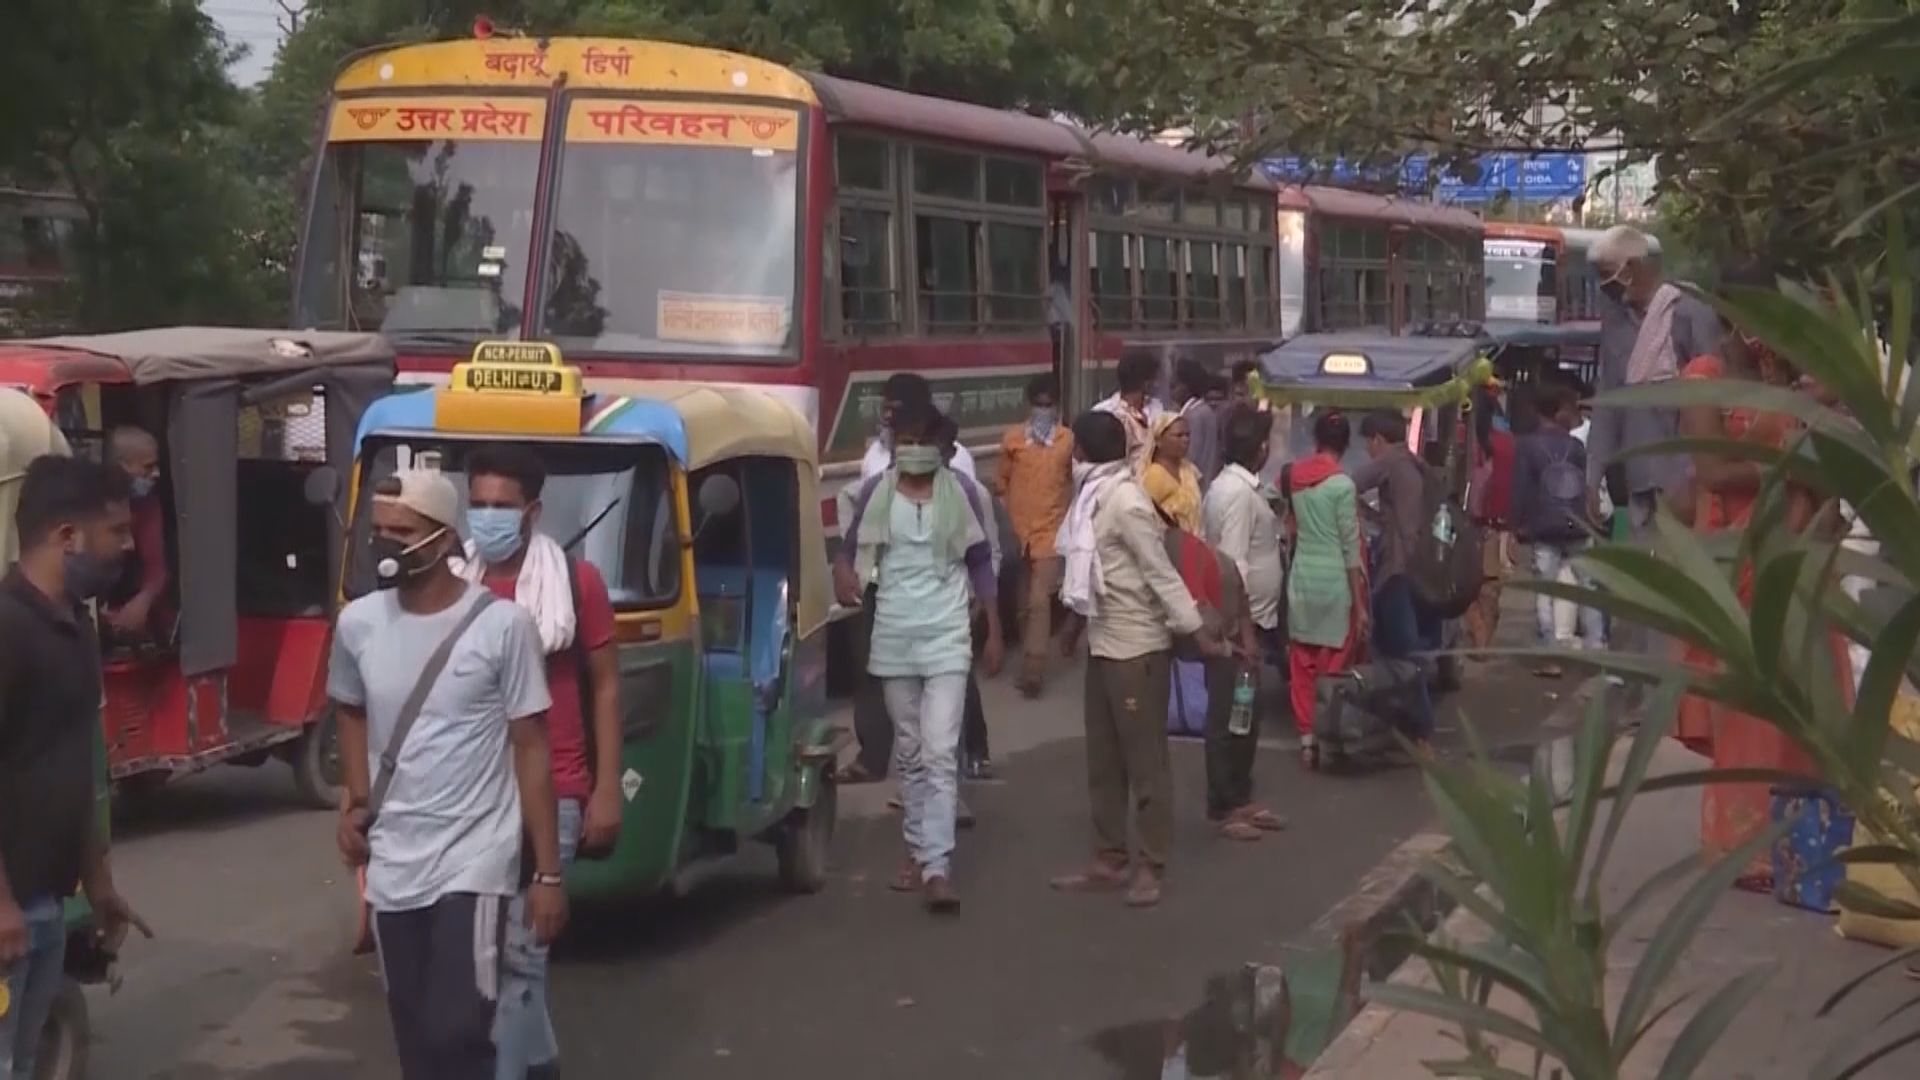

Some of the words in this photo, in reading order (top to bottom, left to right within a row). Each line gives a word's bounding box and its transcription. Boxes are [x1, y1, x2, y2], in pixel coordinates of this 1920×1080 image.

[396, 108, 455, 132] उत्तर
[460, 102, 532, 136] प्रदेश
[587, 103, 737, 138] परिवहन
[473, 370, 517, 388] DELHI
